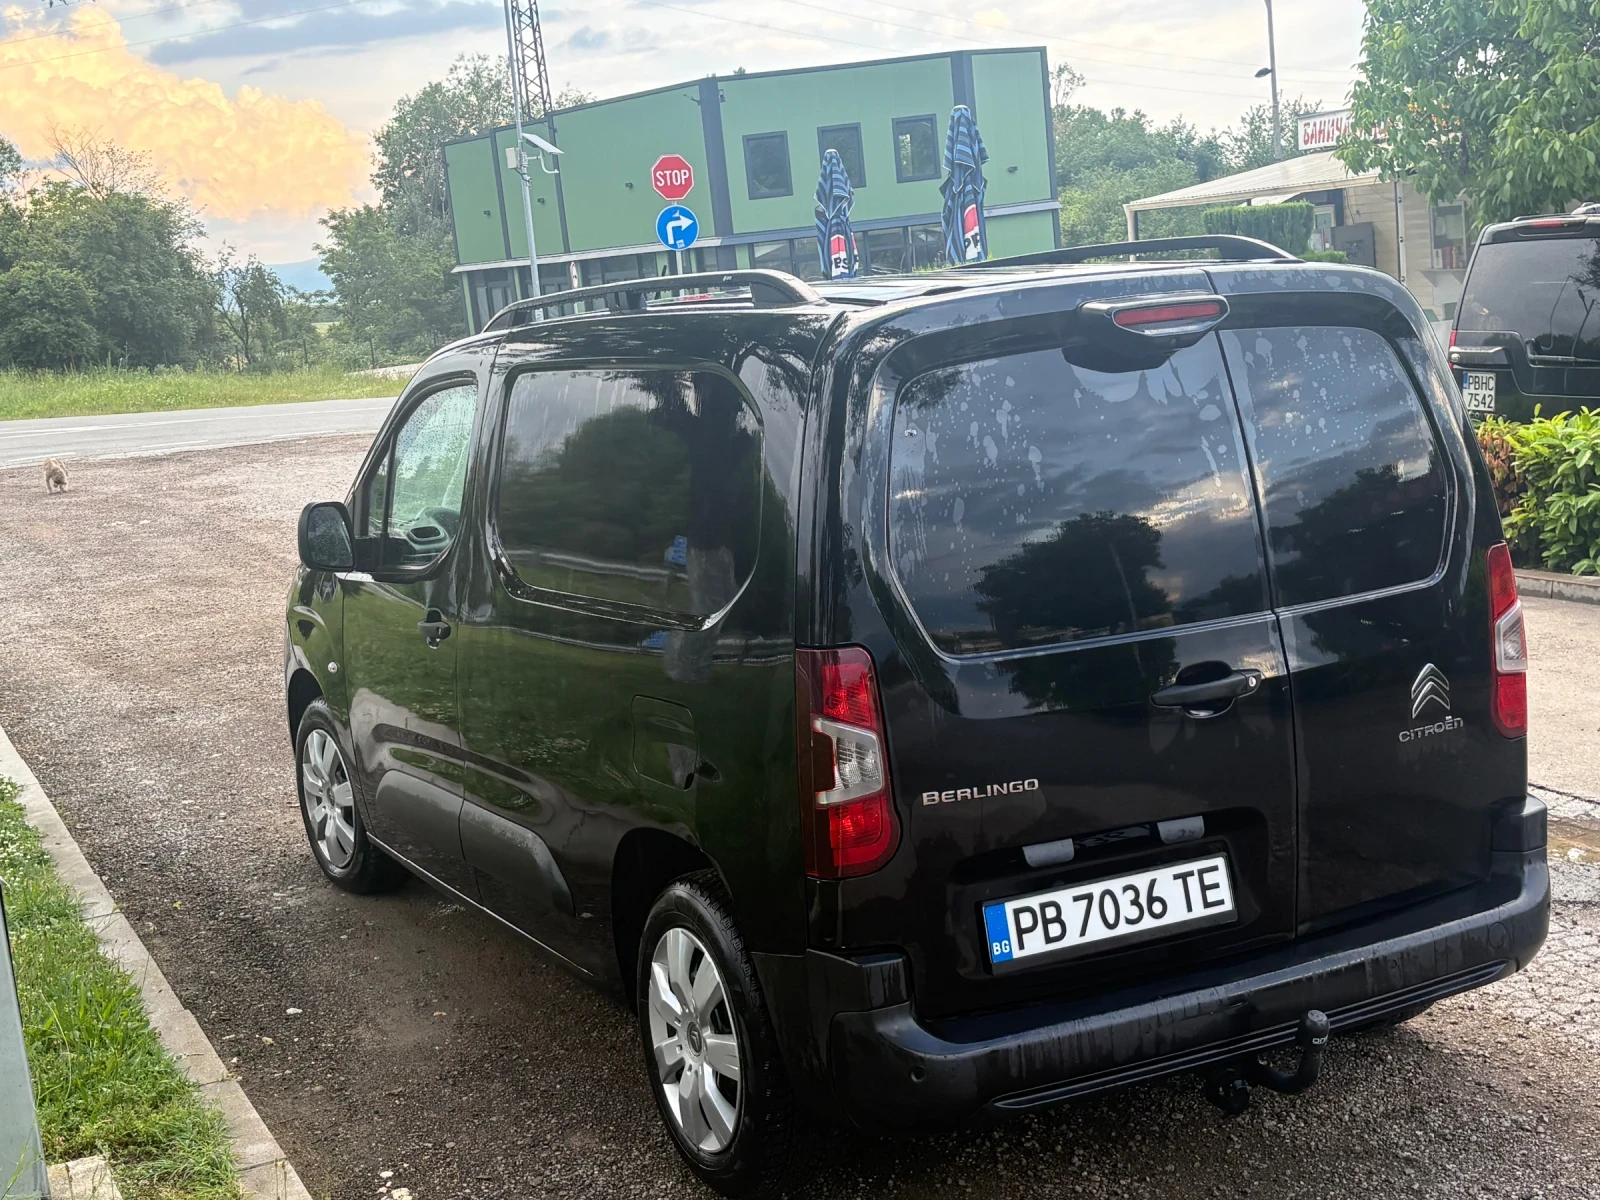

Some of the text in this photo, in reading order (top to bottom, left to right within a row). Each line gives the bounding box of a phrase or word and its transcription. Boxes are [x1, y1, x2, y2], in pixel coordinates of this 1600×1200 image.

[656, 169, 689, 187] STOP
[1468, 375, 1495, 391] PBHC
[1468, 393, 1494, 409] 7542
[1013, 864, 1225, 951] PB 7036 TE
[993, 940, 1010, 956] BG
